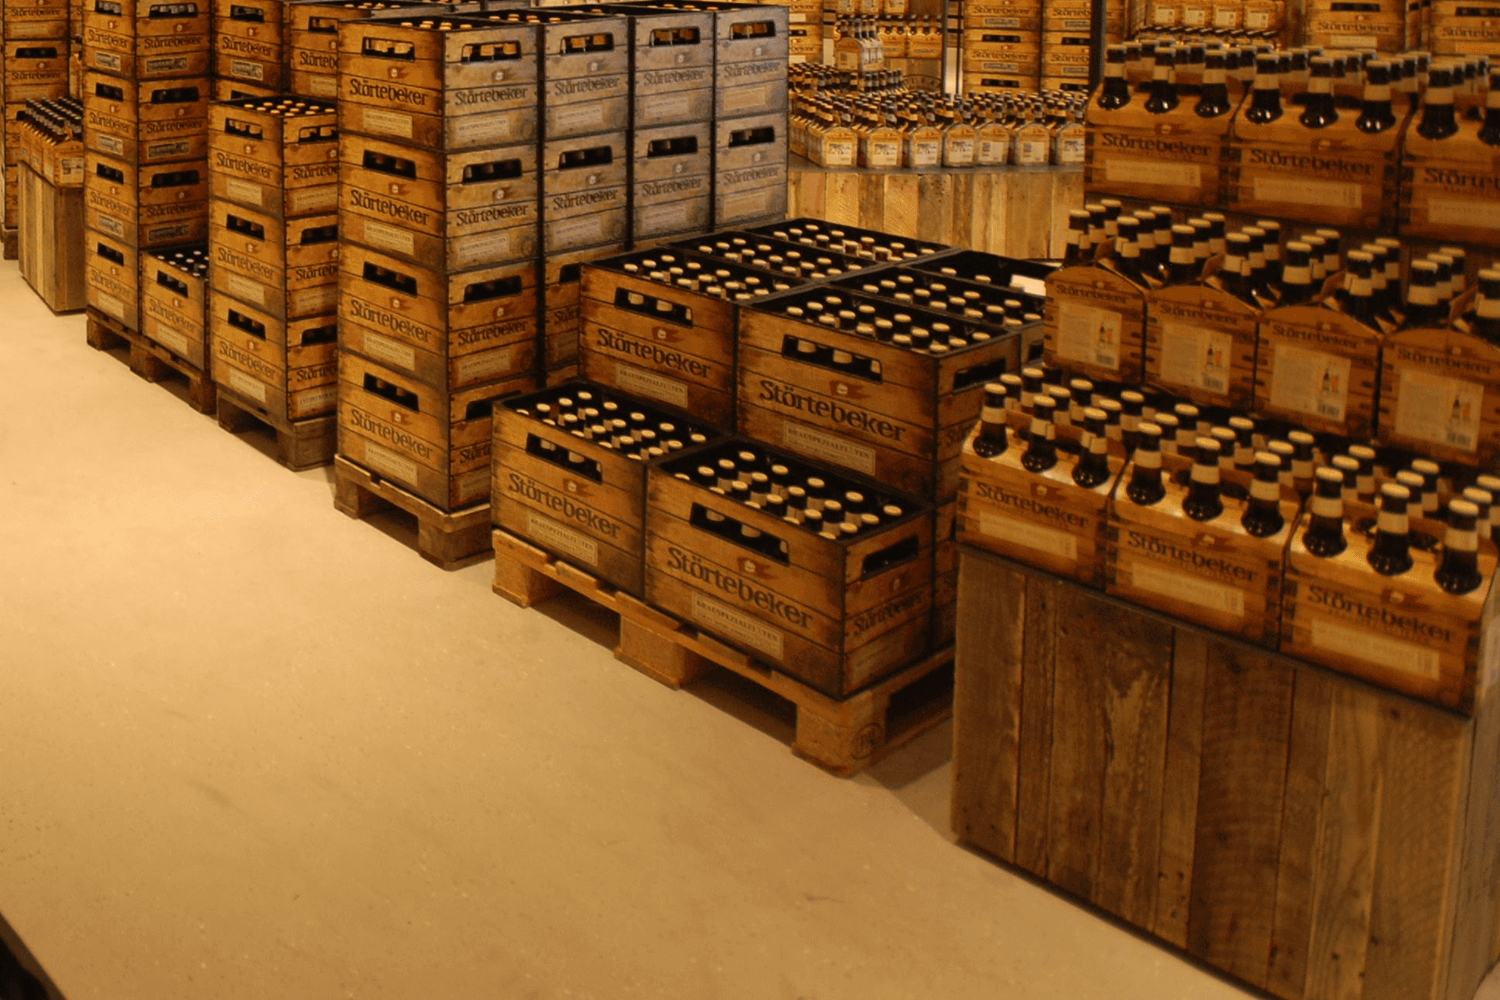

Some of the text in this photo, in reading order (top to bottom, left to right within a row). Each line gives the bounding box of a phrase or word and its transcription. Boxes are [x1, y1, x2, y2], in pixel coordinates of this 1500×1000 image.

[222, 36, 273, 58] Störtebeker
[350, 78, 429, 106] Störtebeker
[554, 76, 620, 96] Störtebeker
[643, 68, 706, 88] Störtebeker
[454, 86, 529, 106] Störtebeker
[1101, 132, 1213, 158] Störtebeker
[217, 153, 273, 179] Störtebeker
[1250, 148, 1375, 177] Störtebeker
[553, 188, 619, 211] Störtebeker
[642, 177, 702, 198] Störtebeker
[350, 189, 430, 226] Störtebeker
[456, 203, 529, 227] Störtebeker
[217, 247, 275, 280] Störtebeker
[350, 300, 431, 343] Störtebeker
[457, 317, 529, 347] Störtebeker
[1272, 323, 1360, 351] Störtebeker
[219, 340, 278, 380] Störtebeker
[596, 327, 712, 378] Störtebeker
[1397, 348, 1494, 377] Störtebeker
[760, 380, 906, 441] Störtebeker
[351, 408, 433, 459] Störtebeker
[508, 473, 621, 540] Störtebeker
[976, 481, 1090, 529] Störtebeker
[1127, 531, 1258, 583] Störtebeker
[667, 547, 814, 630] Störtebeker
[1308, 586, 1455, 644] Störtebeker
